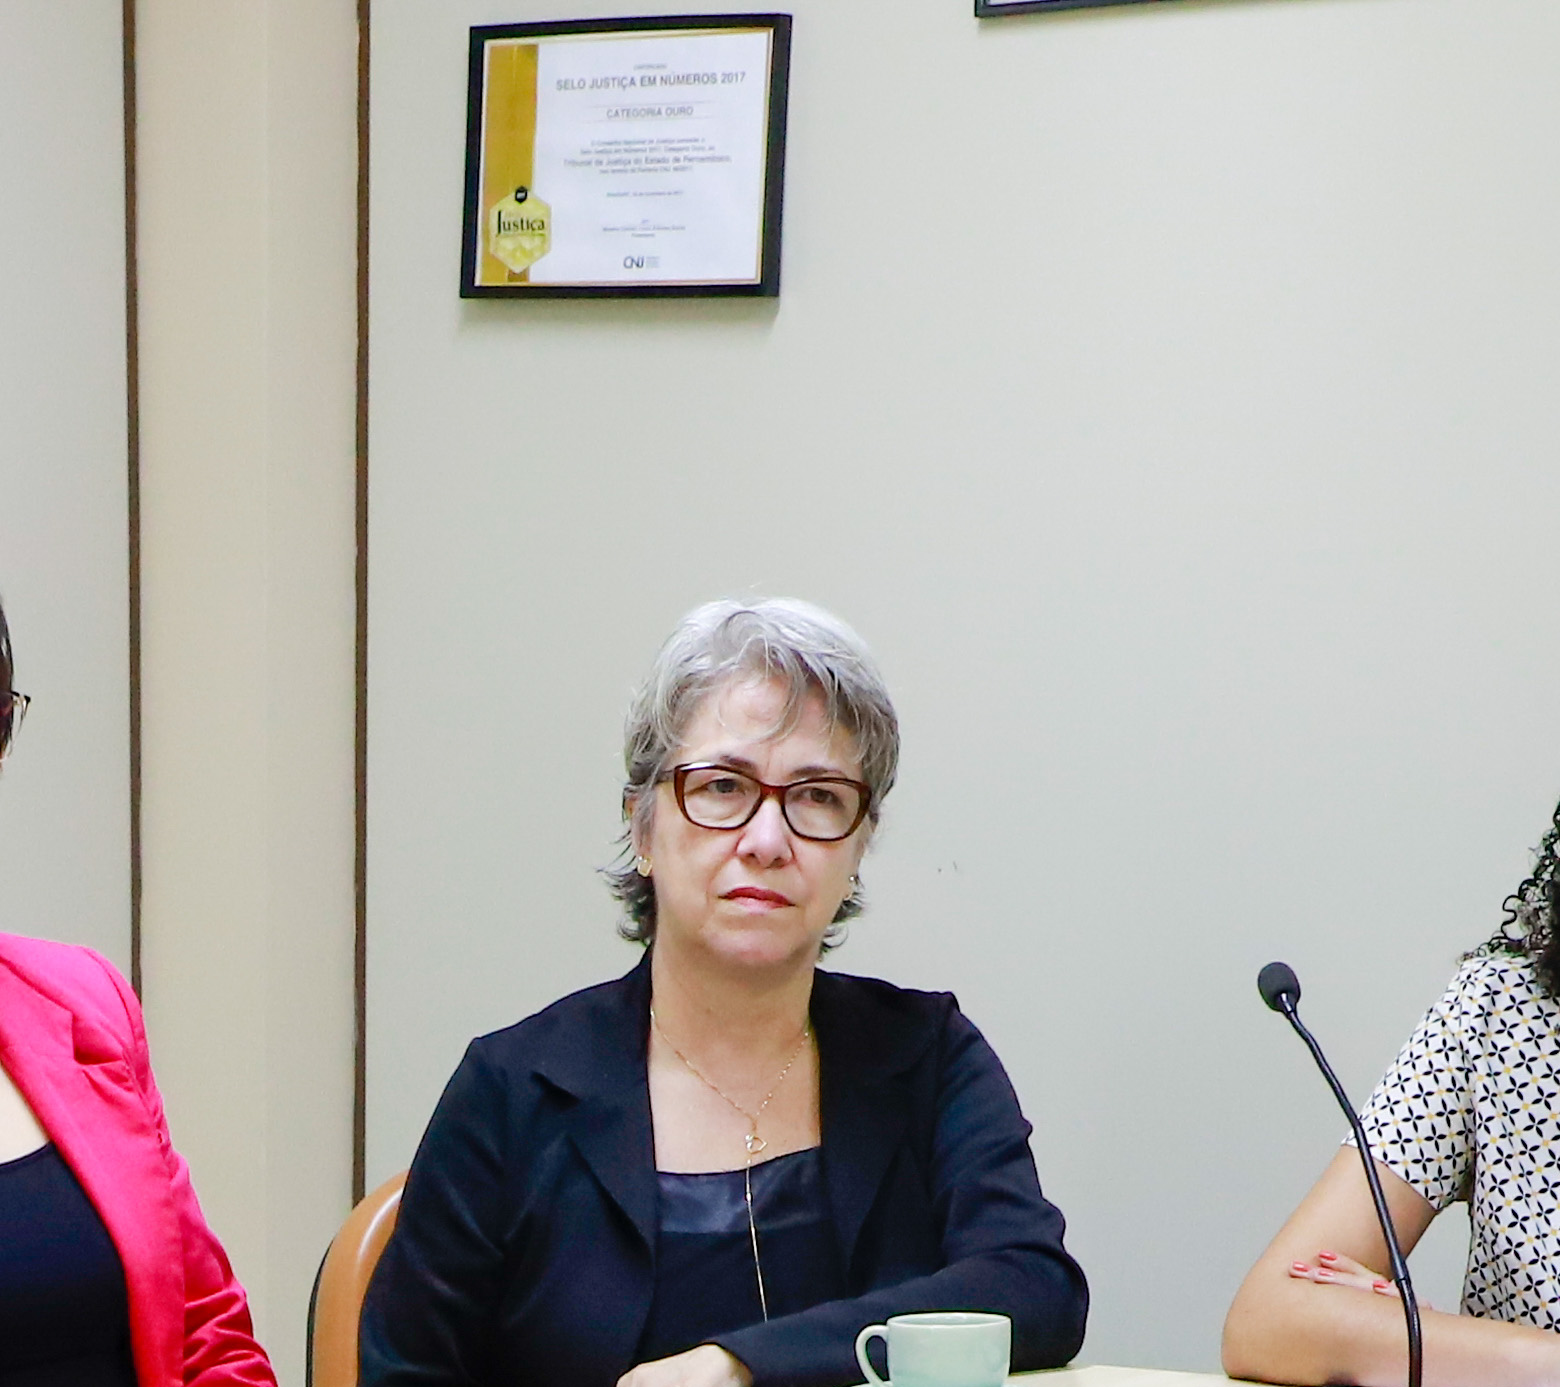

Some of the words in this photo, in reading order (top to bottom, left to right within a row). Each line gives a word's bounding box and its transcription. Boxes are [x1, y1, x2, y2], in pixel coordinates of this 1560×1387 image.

[556, 78, 586, 91] SELO
[589, 76, 636, 92] JUSTIÇA
[640, 74, 657, 87] EM
[660, 71, 718, 86] NÚMEROS
[721, 70, 746, 84] 2017
[606, 107, 662, 119] CATEGORIA
[665, 105, 694, 117] OURO
[623, 255, 645, 269] CNJ
